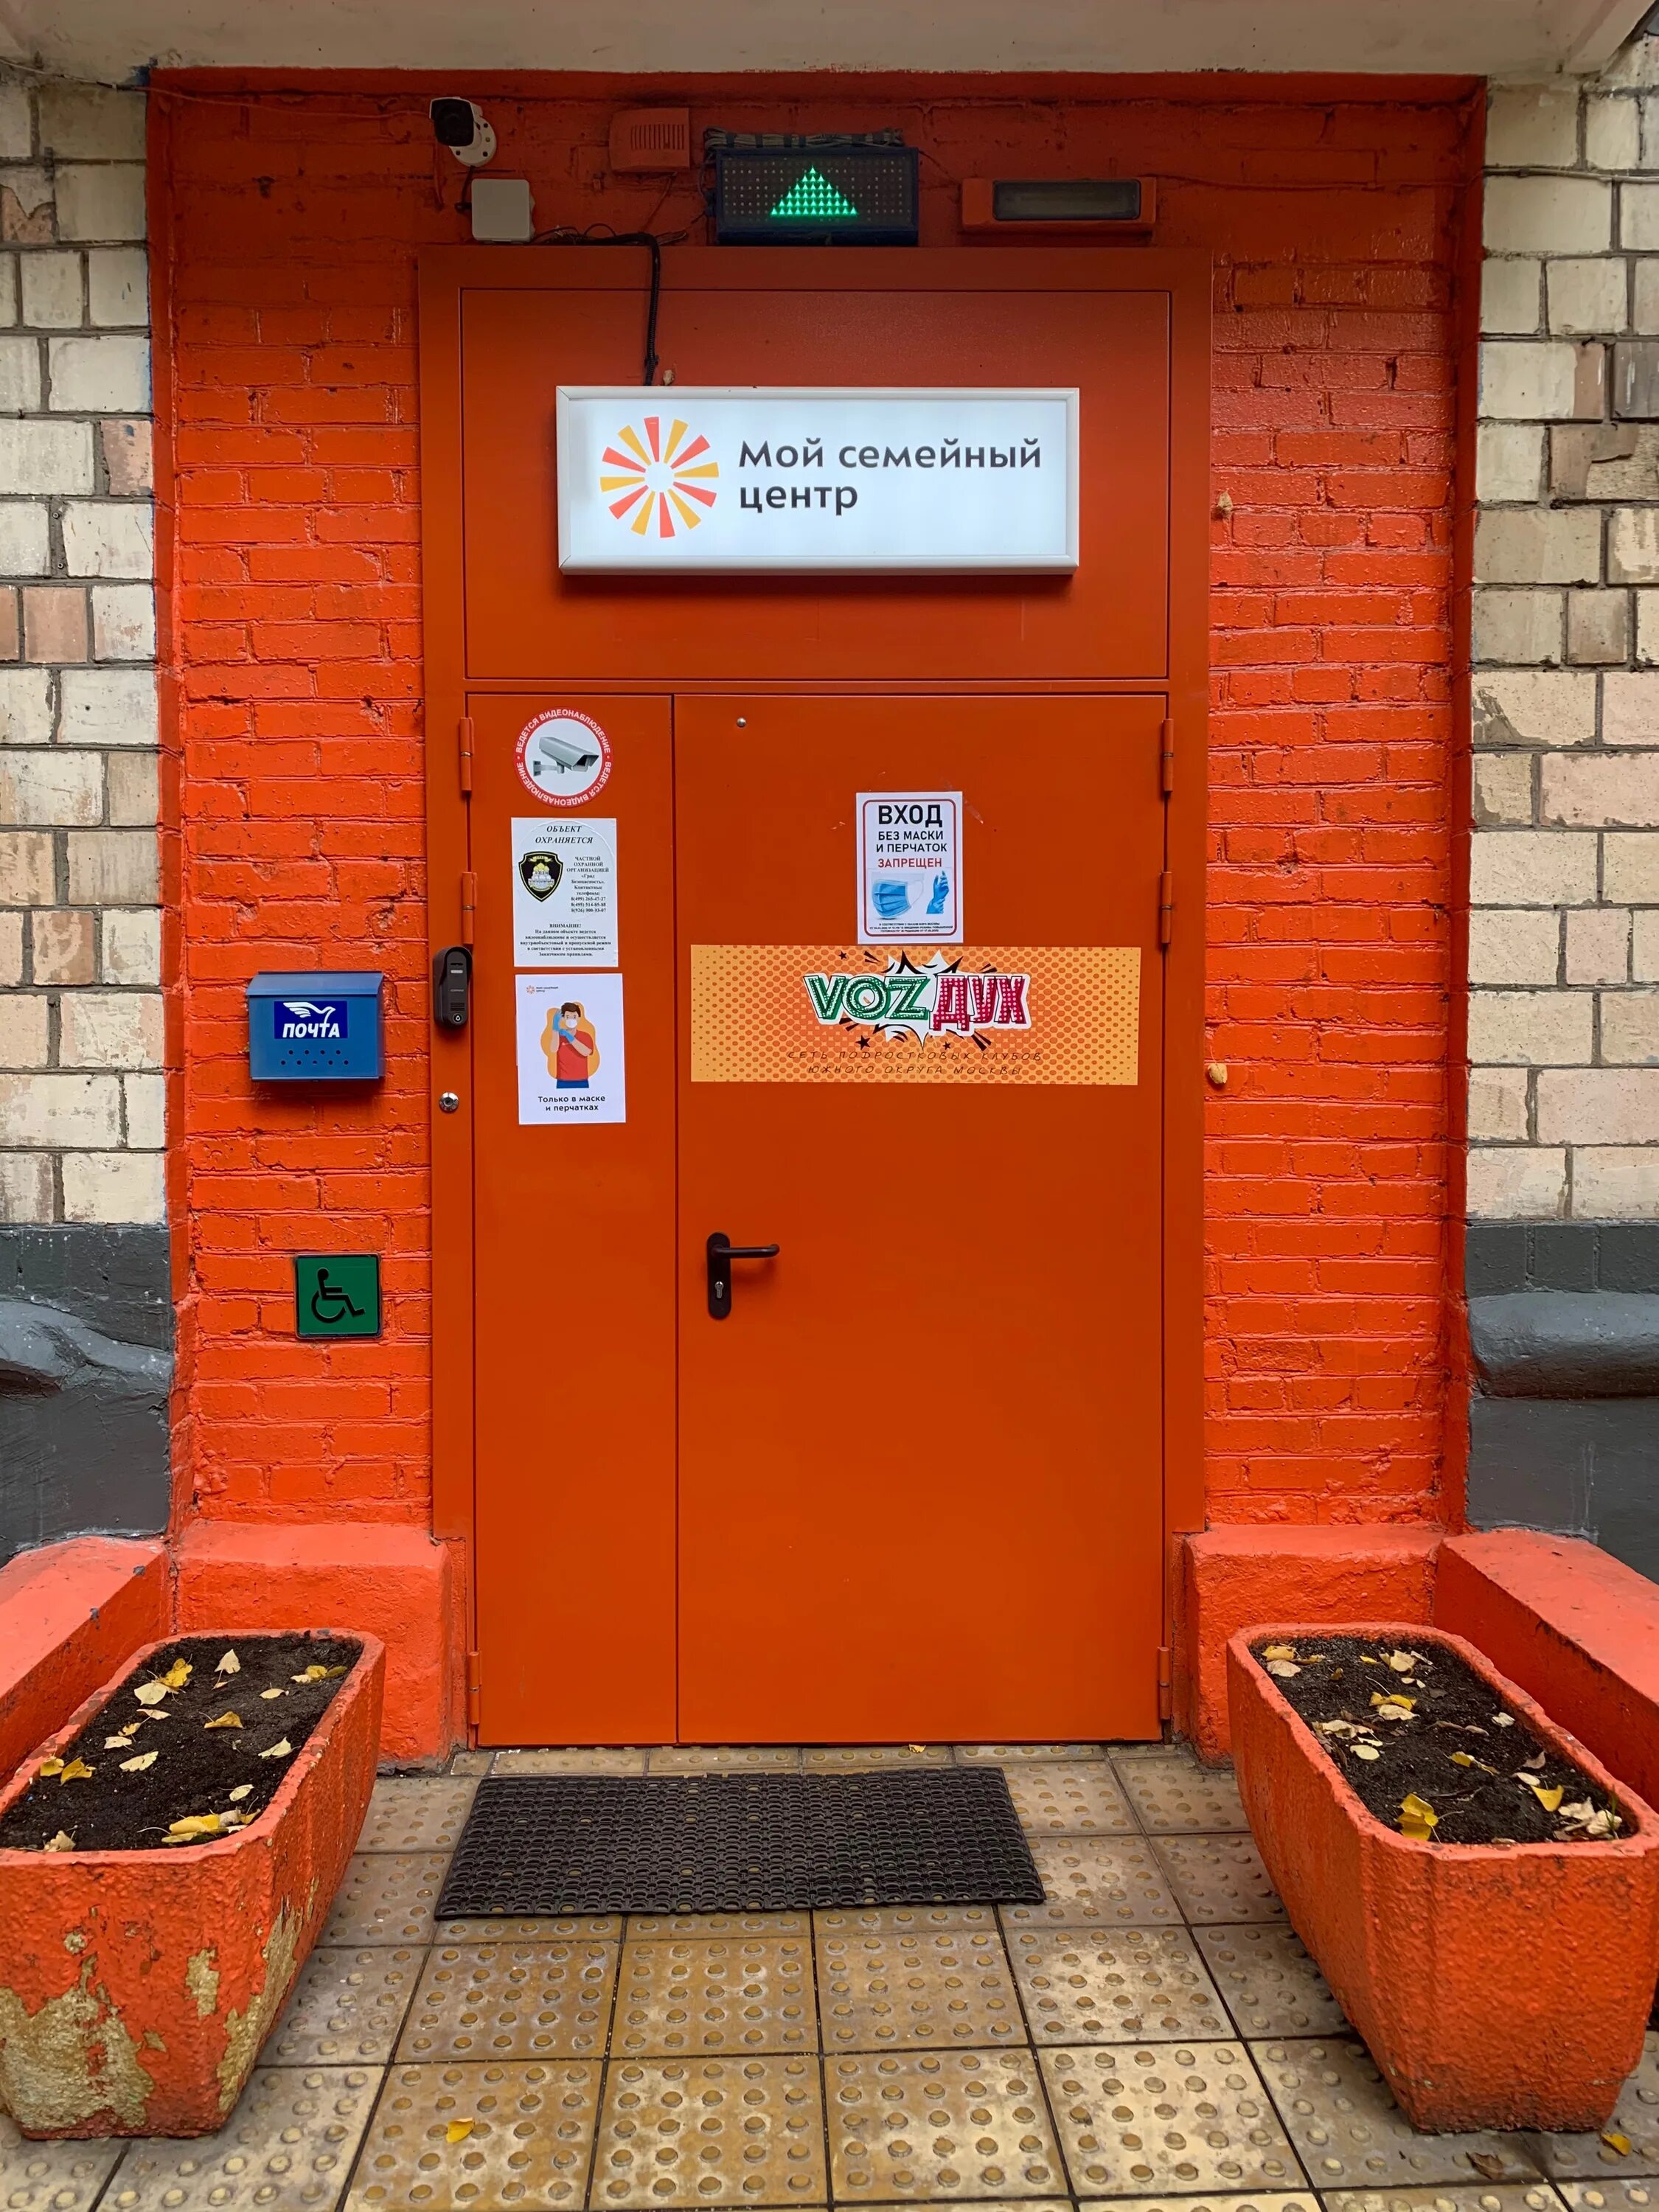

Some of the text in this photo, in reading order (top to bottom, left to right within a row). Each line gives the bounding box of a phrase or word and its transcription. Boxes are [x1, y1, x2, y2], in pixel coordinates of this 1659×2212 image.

[739, 437, 1041, 468] Мой семейный
[739, 483, 858, 516] центр
[516, 709, 611, 754] ВЕДЕТСЯ ВИДЕОНАБЛЮДЕНИЕ
[516, 762, 611, 806] ВЕДЕТСЯ ВИДЕОНАБЛЮДЕНИЕ
[878, 805, 943, 827] ВХОД
[878, 830, 943, 840] БЕЗ МАСКИ
[876, 843, 947, 852] И ПЕРЧАТОК
[878, 858, 942, 869] ЗАПРЕЩЕН
[282, 1023, 340, 1038] ПОЧТА
[788, 1050, 1042, 1061] СЕТЬ ПОДРОСТКОВЫХ КЛУБОВ
[808, 1065, 1022, 1075] ЮЖНОГО ОКРУГА МОСКВЫ
[554, 1104, 599, 1113] перчатках
